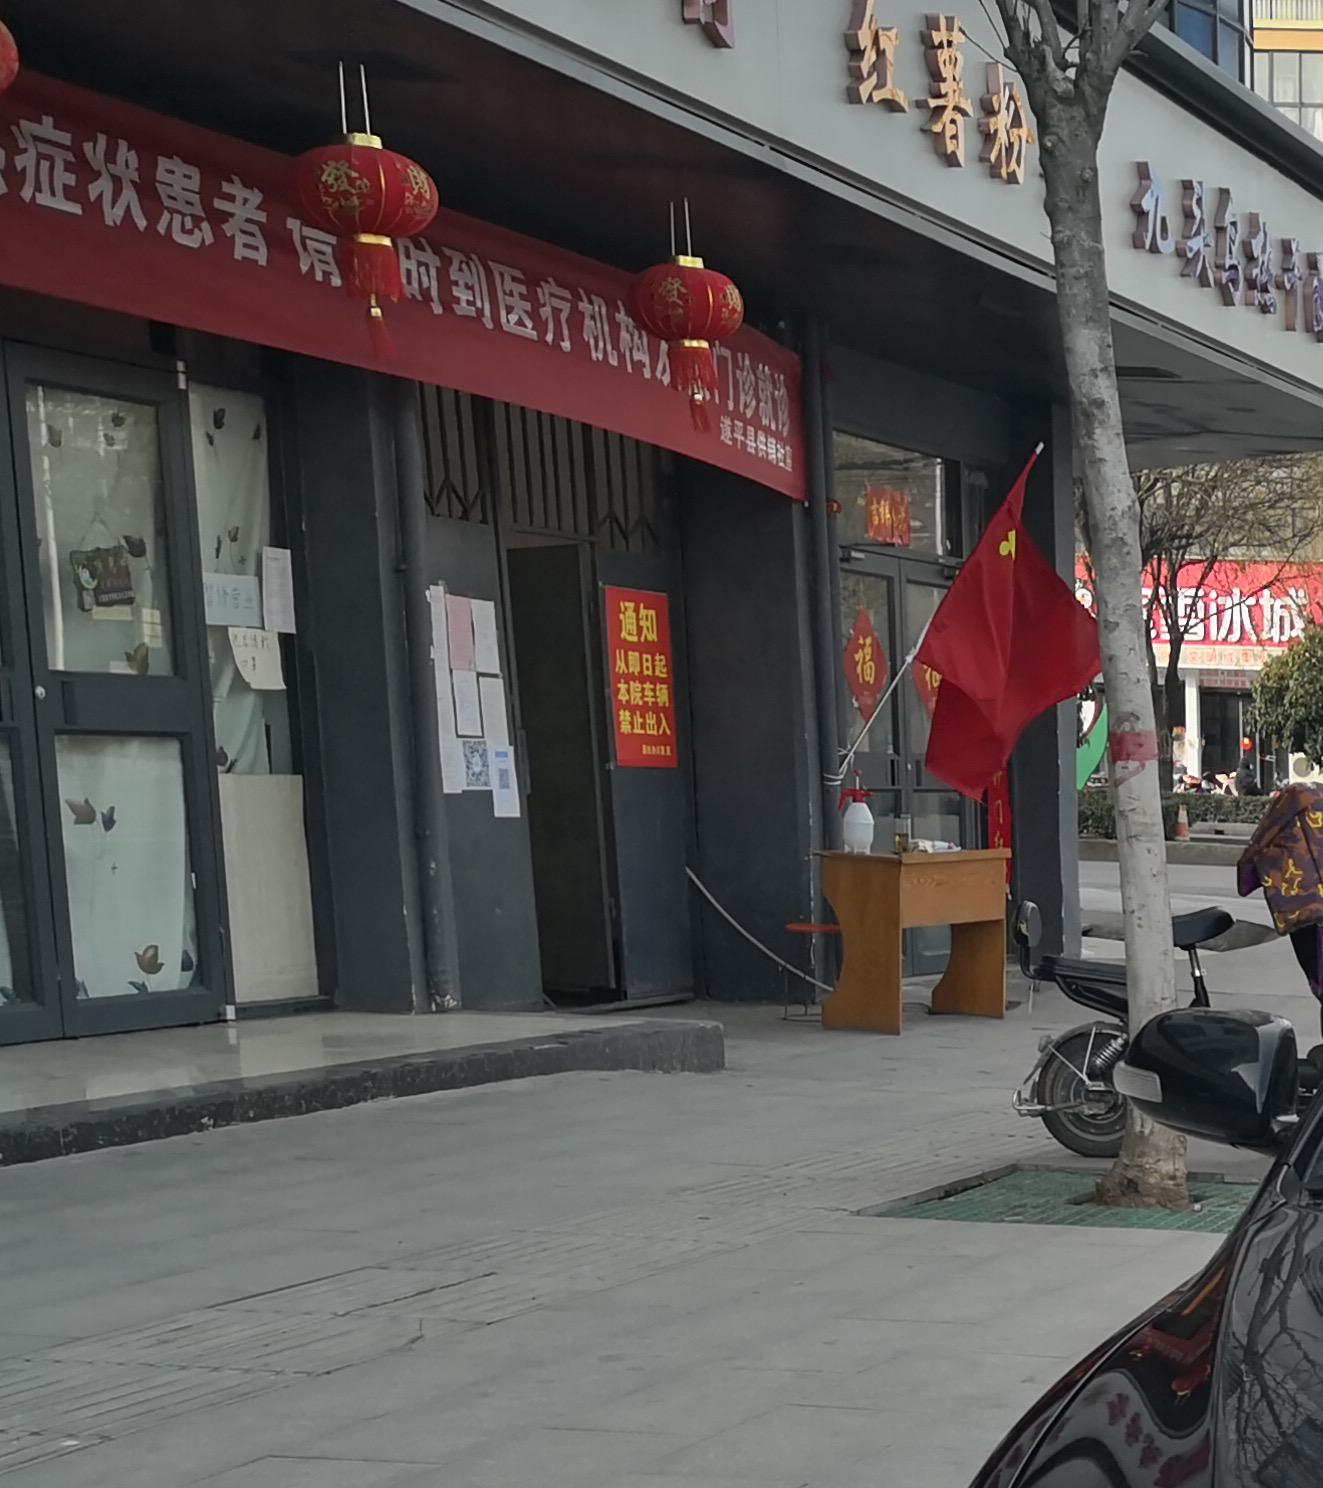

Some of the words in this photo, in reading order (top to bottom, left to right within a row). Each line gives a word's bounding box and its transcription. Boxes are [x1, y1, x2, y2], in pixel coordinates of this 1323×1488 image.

[0, 115, 270, 266] 症状患者
[619, 600, 658, 643] 通知
[615, 649, 669, 679] 从即日起
[854, 635, 876, 686] 福
[617, 679, 670, 707] 本院车辆
[619, 708, 672, 737] 禁止出入
